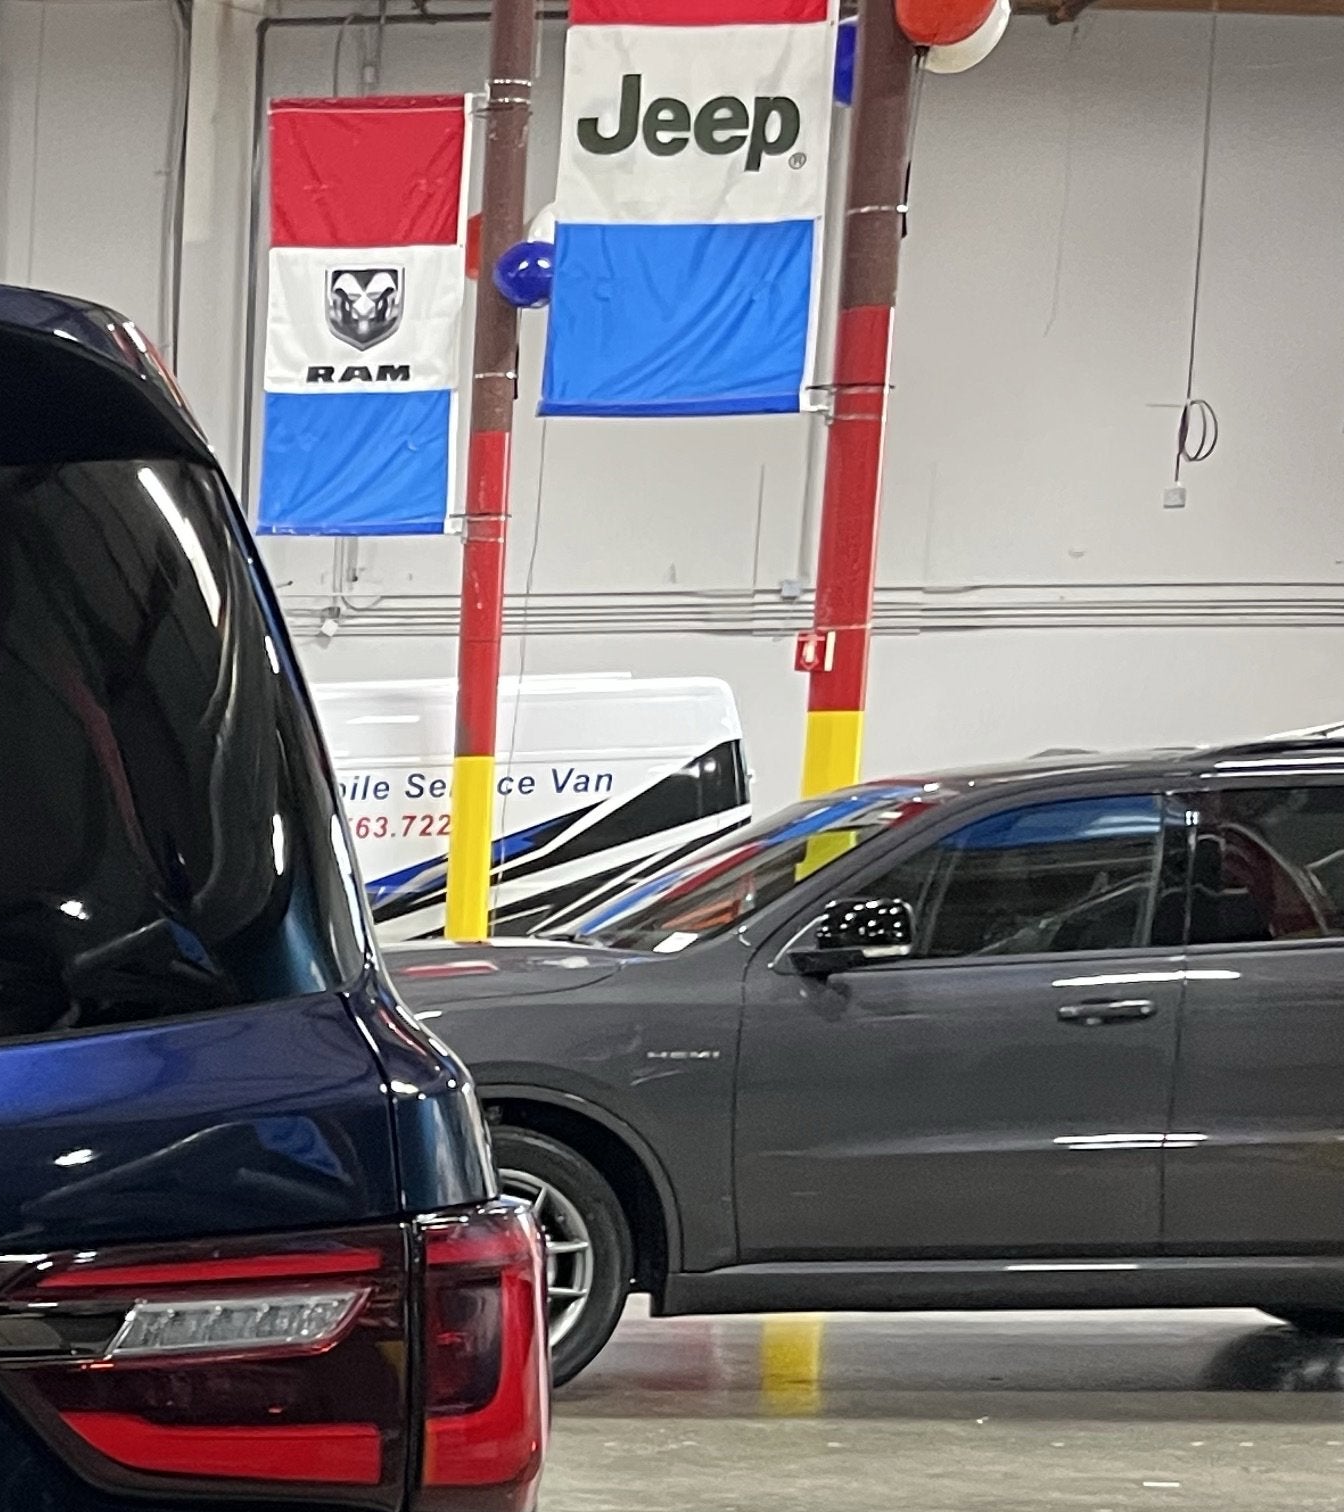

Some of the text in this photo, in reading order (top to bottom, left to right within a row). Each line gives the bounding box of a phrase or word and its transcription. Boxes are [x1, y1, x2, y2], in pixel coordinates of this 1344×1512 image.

[576, 74, 802, 172] Jeep
[306, 365, 411, 383] RAM
[551, 767, 613, 793] Van
